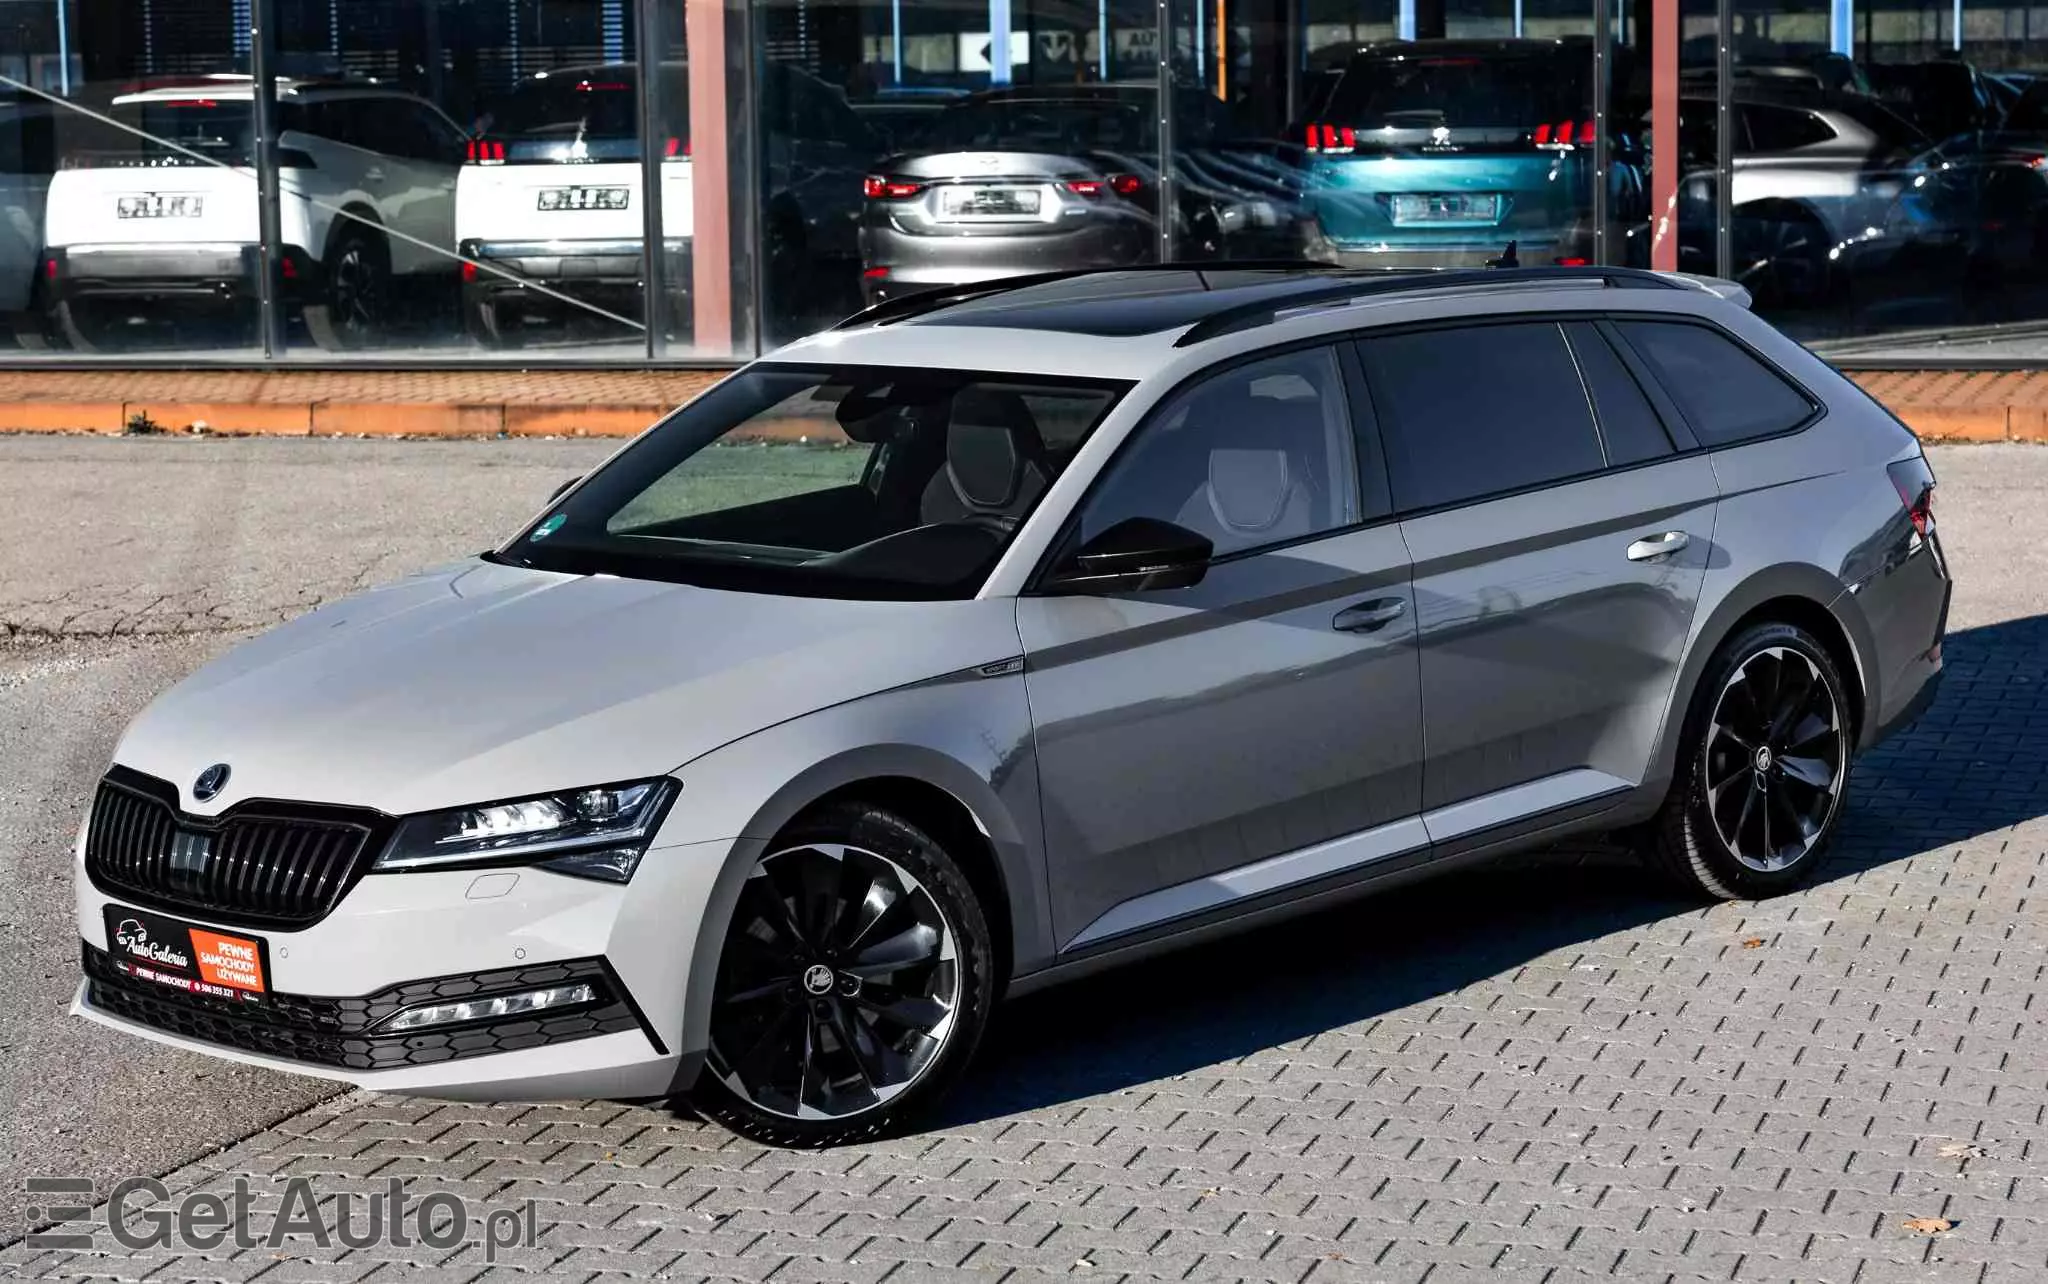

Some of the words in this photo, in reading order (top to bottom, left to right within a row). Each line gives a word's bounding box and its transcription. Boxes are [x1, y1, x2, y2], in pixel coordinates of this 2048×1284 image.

[127, 936, 188, 967] AutoGaleria
[218, 941, 253, 960] PEWNE
[201, 951, 256, 973] SAMOCHODY
[136, 967, 155, 980] PEWNE
[155, 972, 192, 990] SAMOCHODY
